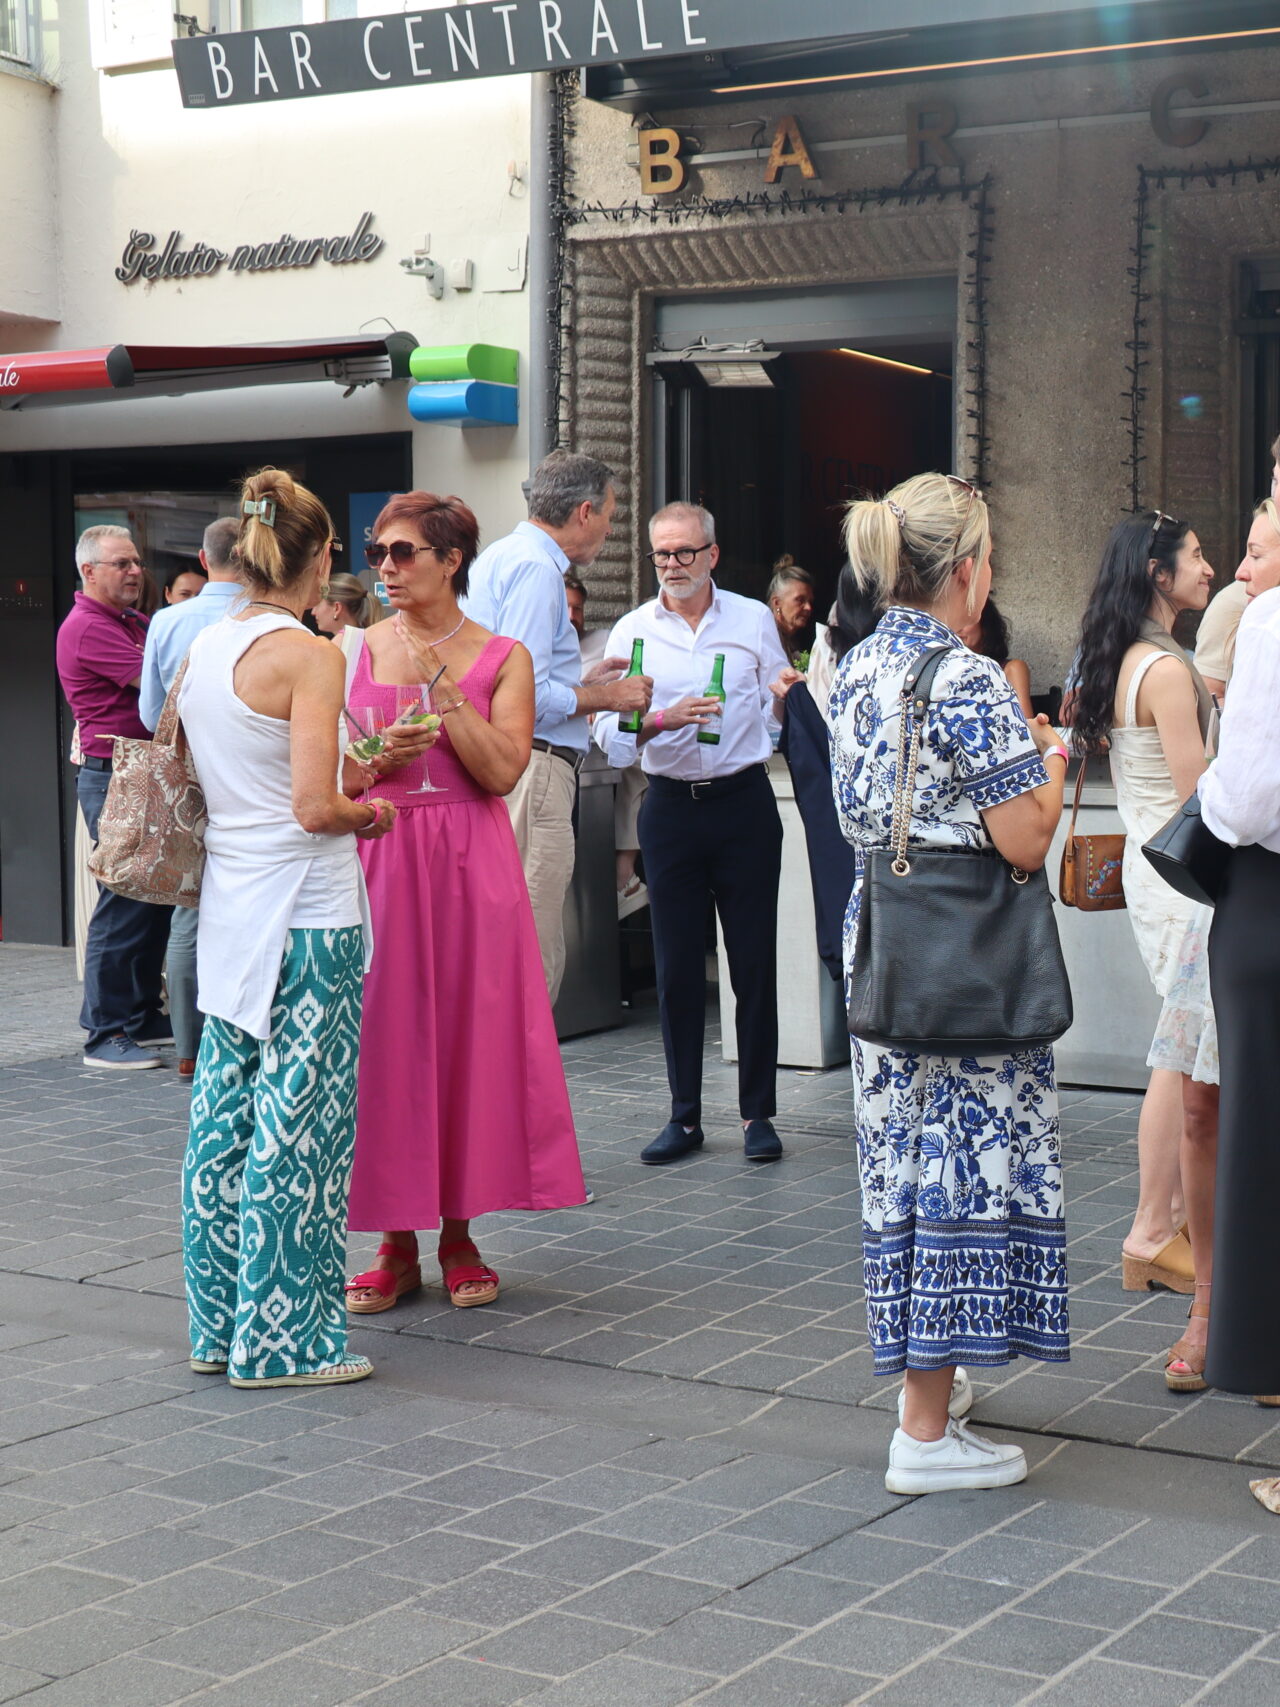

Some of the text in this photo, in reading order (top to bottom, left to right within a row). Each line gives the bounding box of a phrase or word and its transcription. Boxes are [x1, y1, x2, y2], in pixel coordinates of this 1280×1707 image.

[206, 0, 706, 100] BAR CENTRALE
[638, 101, 963, 195] BAR
[114, 210, 384, 282] Gelato naturale
